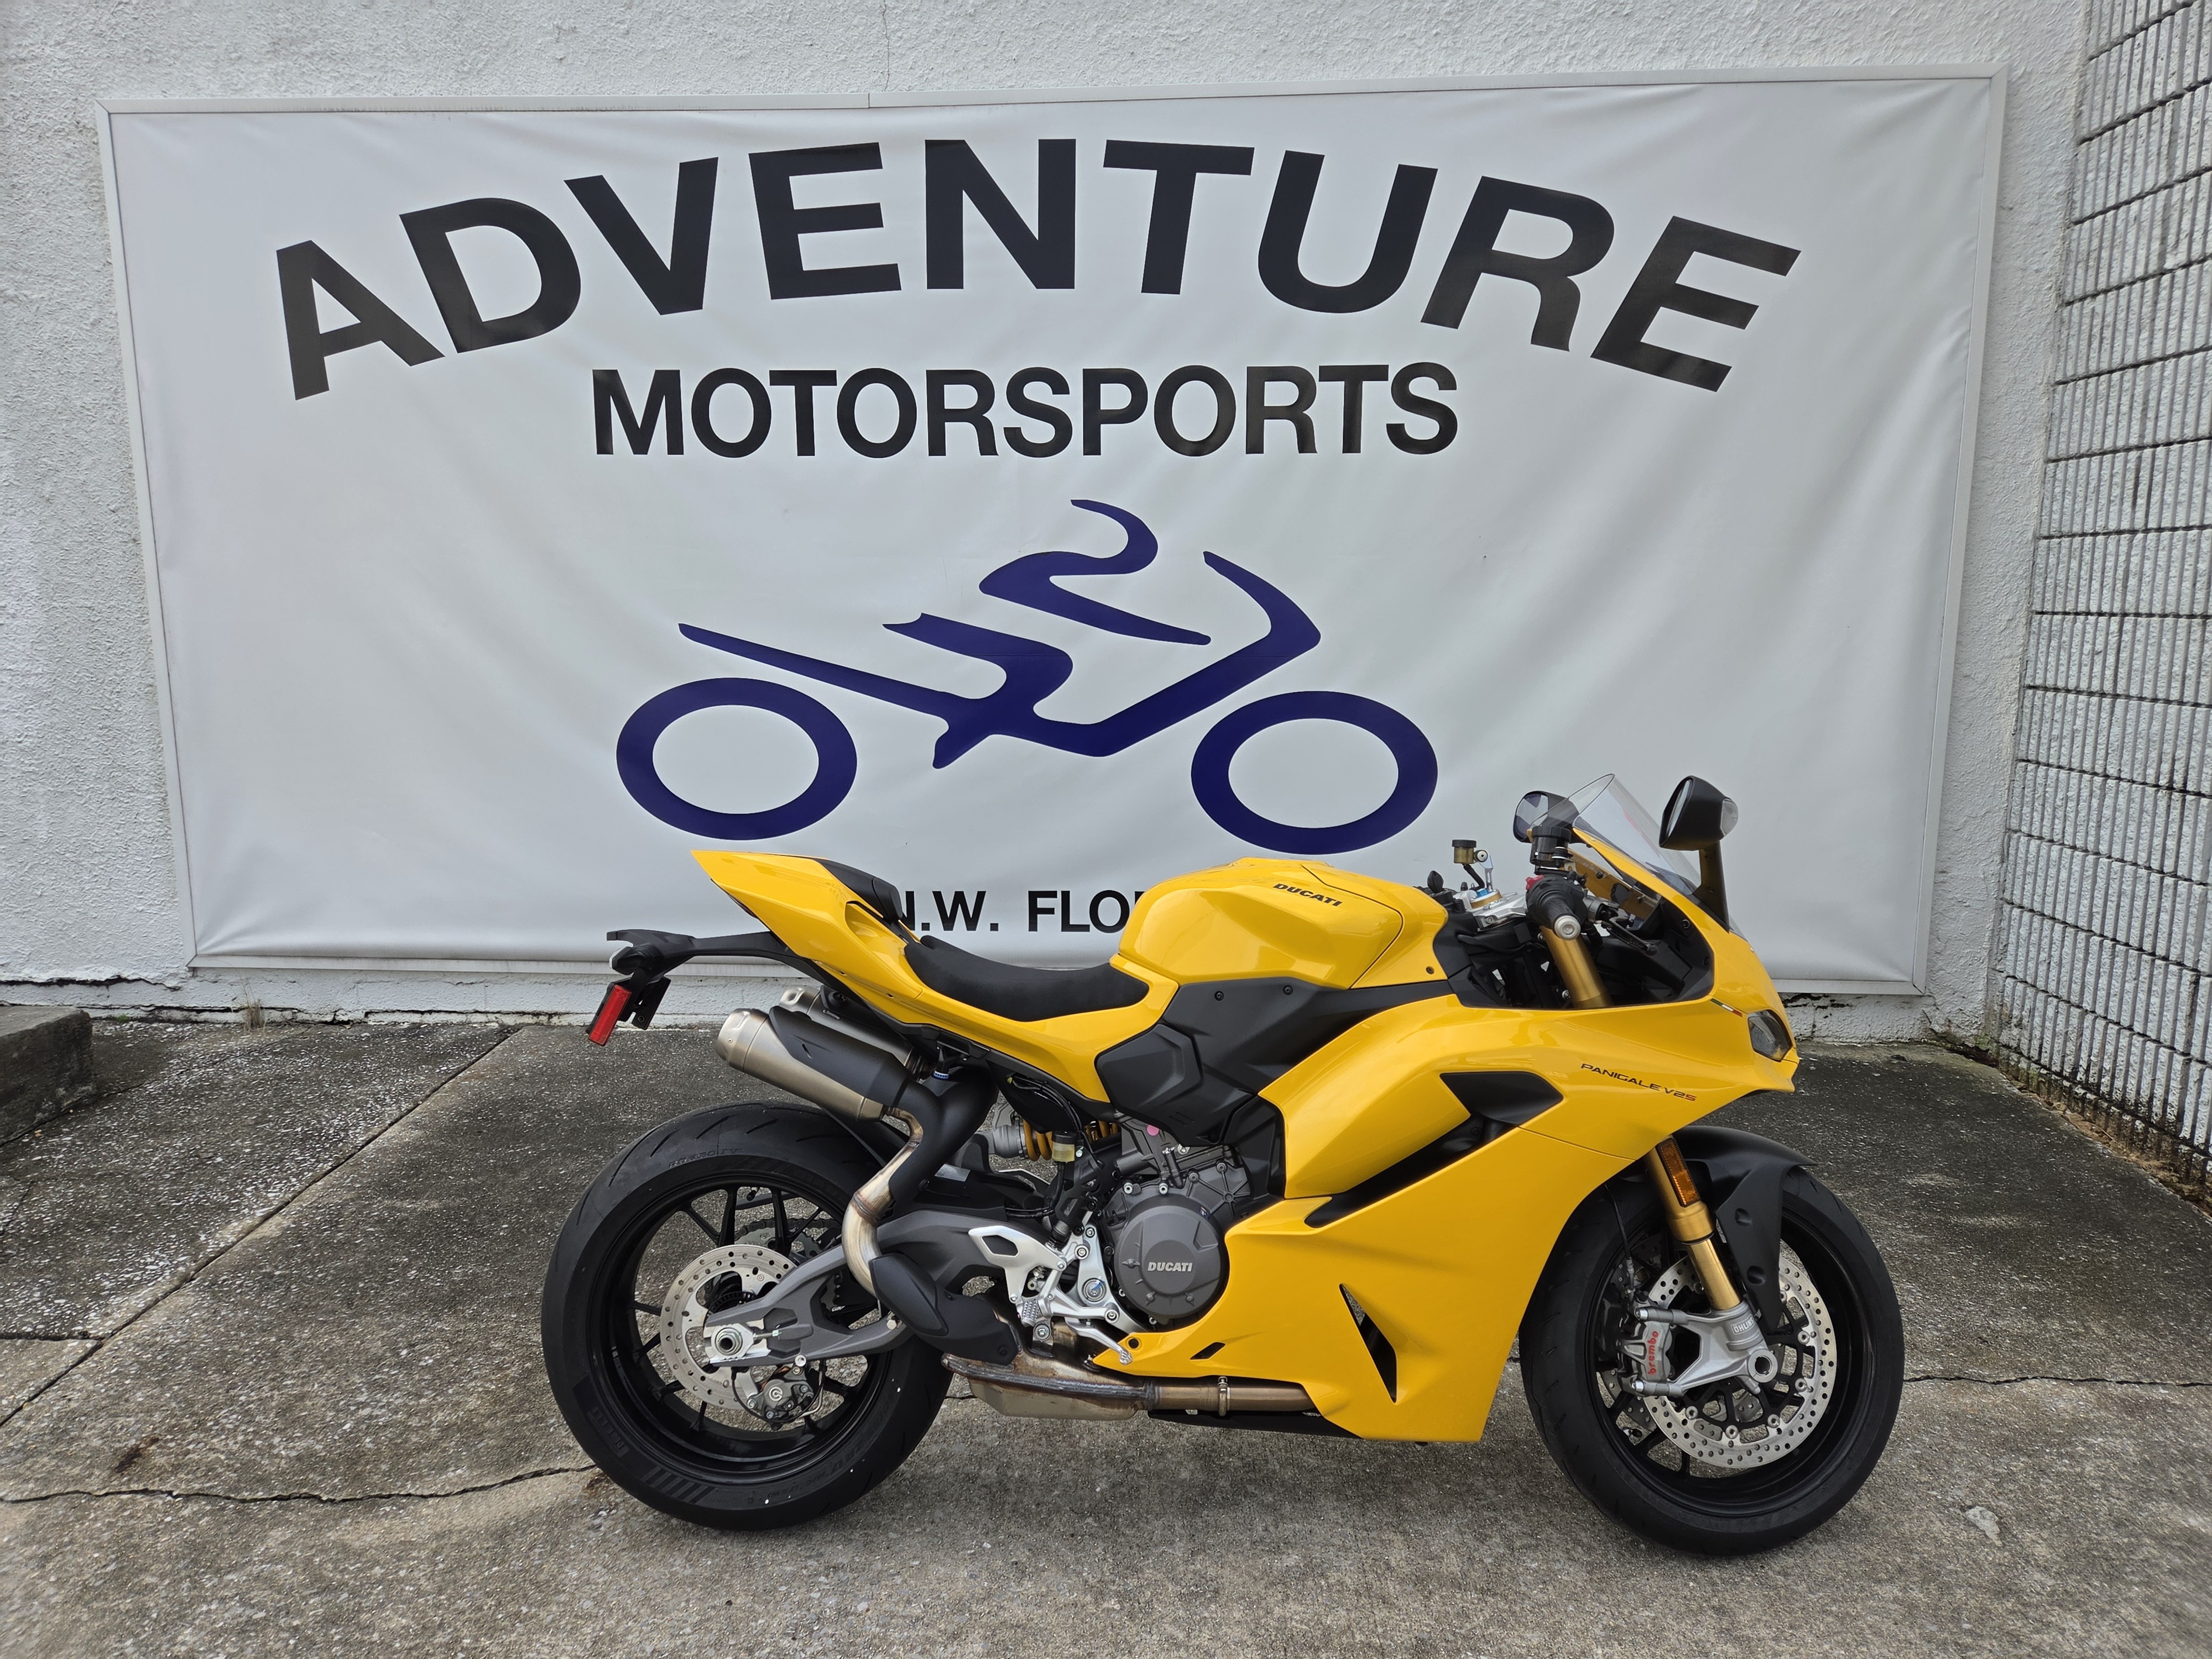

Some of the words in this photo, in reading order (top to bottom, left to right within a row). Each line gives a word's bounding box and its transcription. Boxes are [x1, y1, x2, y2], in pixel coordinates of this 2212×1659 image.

[276, 138, 1802, 400] ADVENTURE
[592, 362, 1458, 458] MOTORSPORTS
[1028, 889, 1145, 933] FLO
[1272, 883, 1343, 906] DUCATI
[1580, 1063, 1662, 1091] PANIGALE
[1664, 1087, 1697, 1102] V2S
[1147, 1262, 1193, 1272] DUCATI
[1647, 1331, 1659, 1375] brembo
